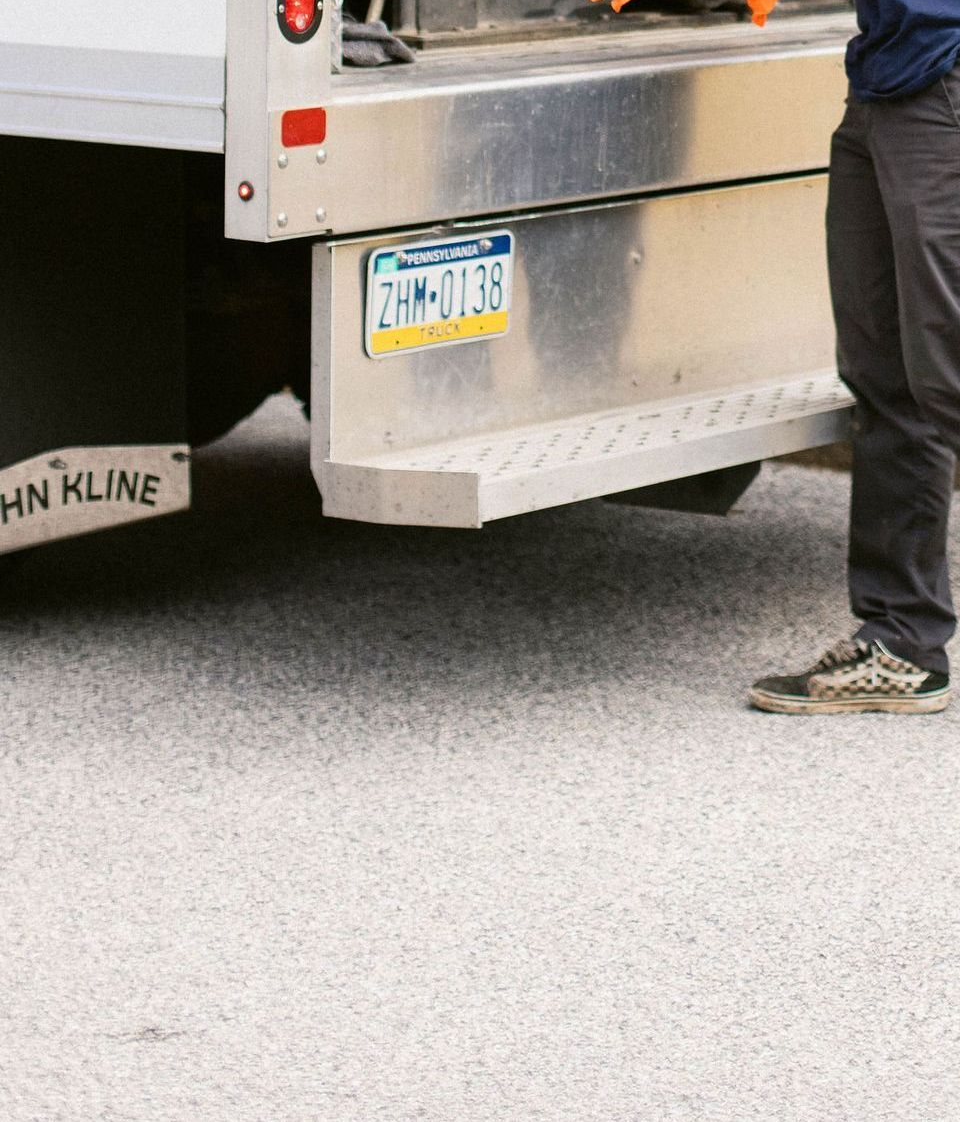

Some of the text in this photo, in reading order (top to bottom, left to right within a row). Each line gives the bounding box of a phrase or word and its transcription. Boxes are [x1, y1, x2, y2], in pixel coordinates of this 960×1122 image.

[406, 244, 480, 266] PENNSYLVANIA
[420, 323, 460, 339] TRUCK
[0, 469, 161, 524] HN KLINE
